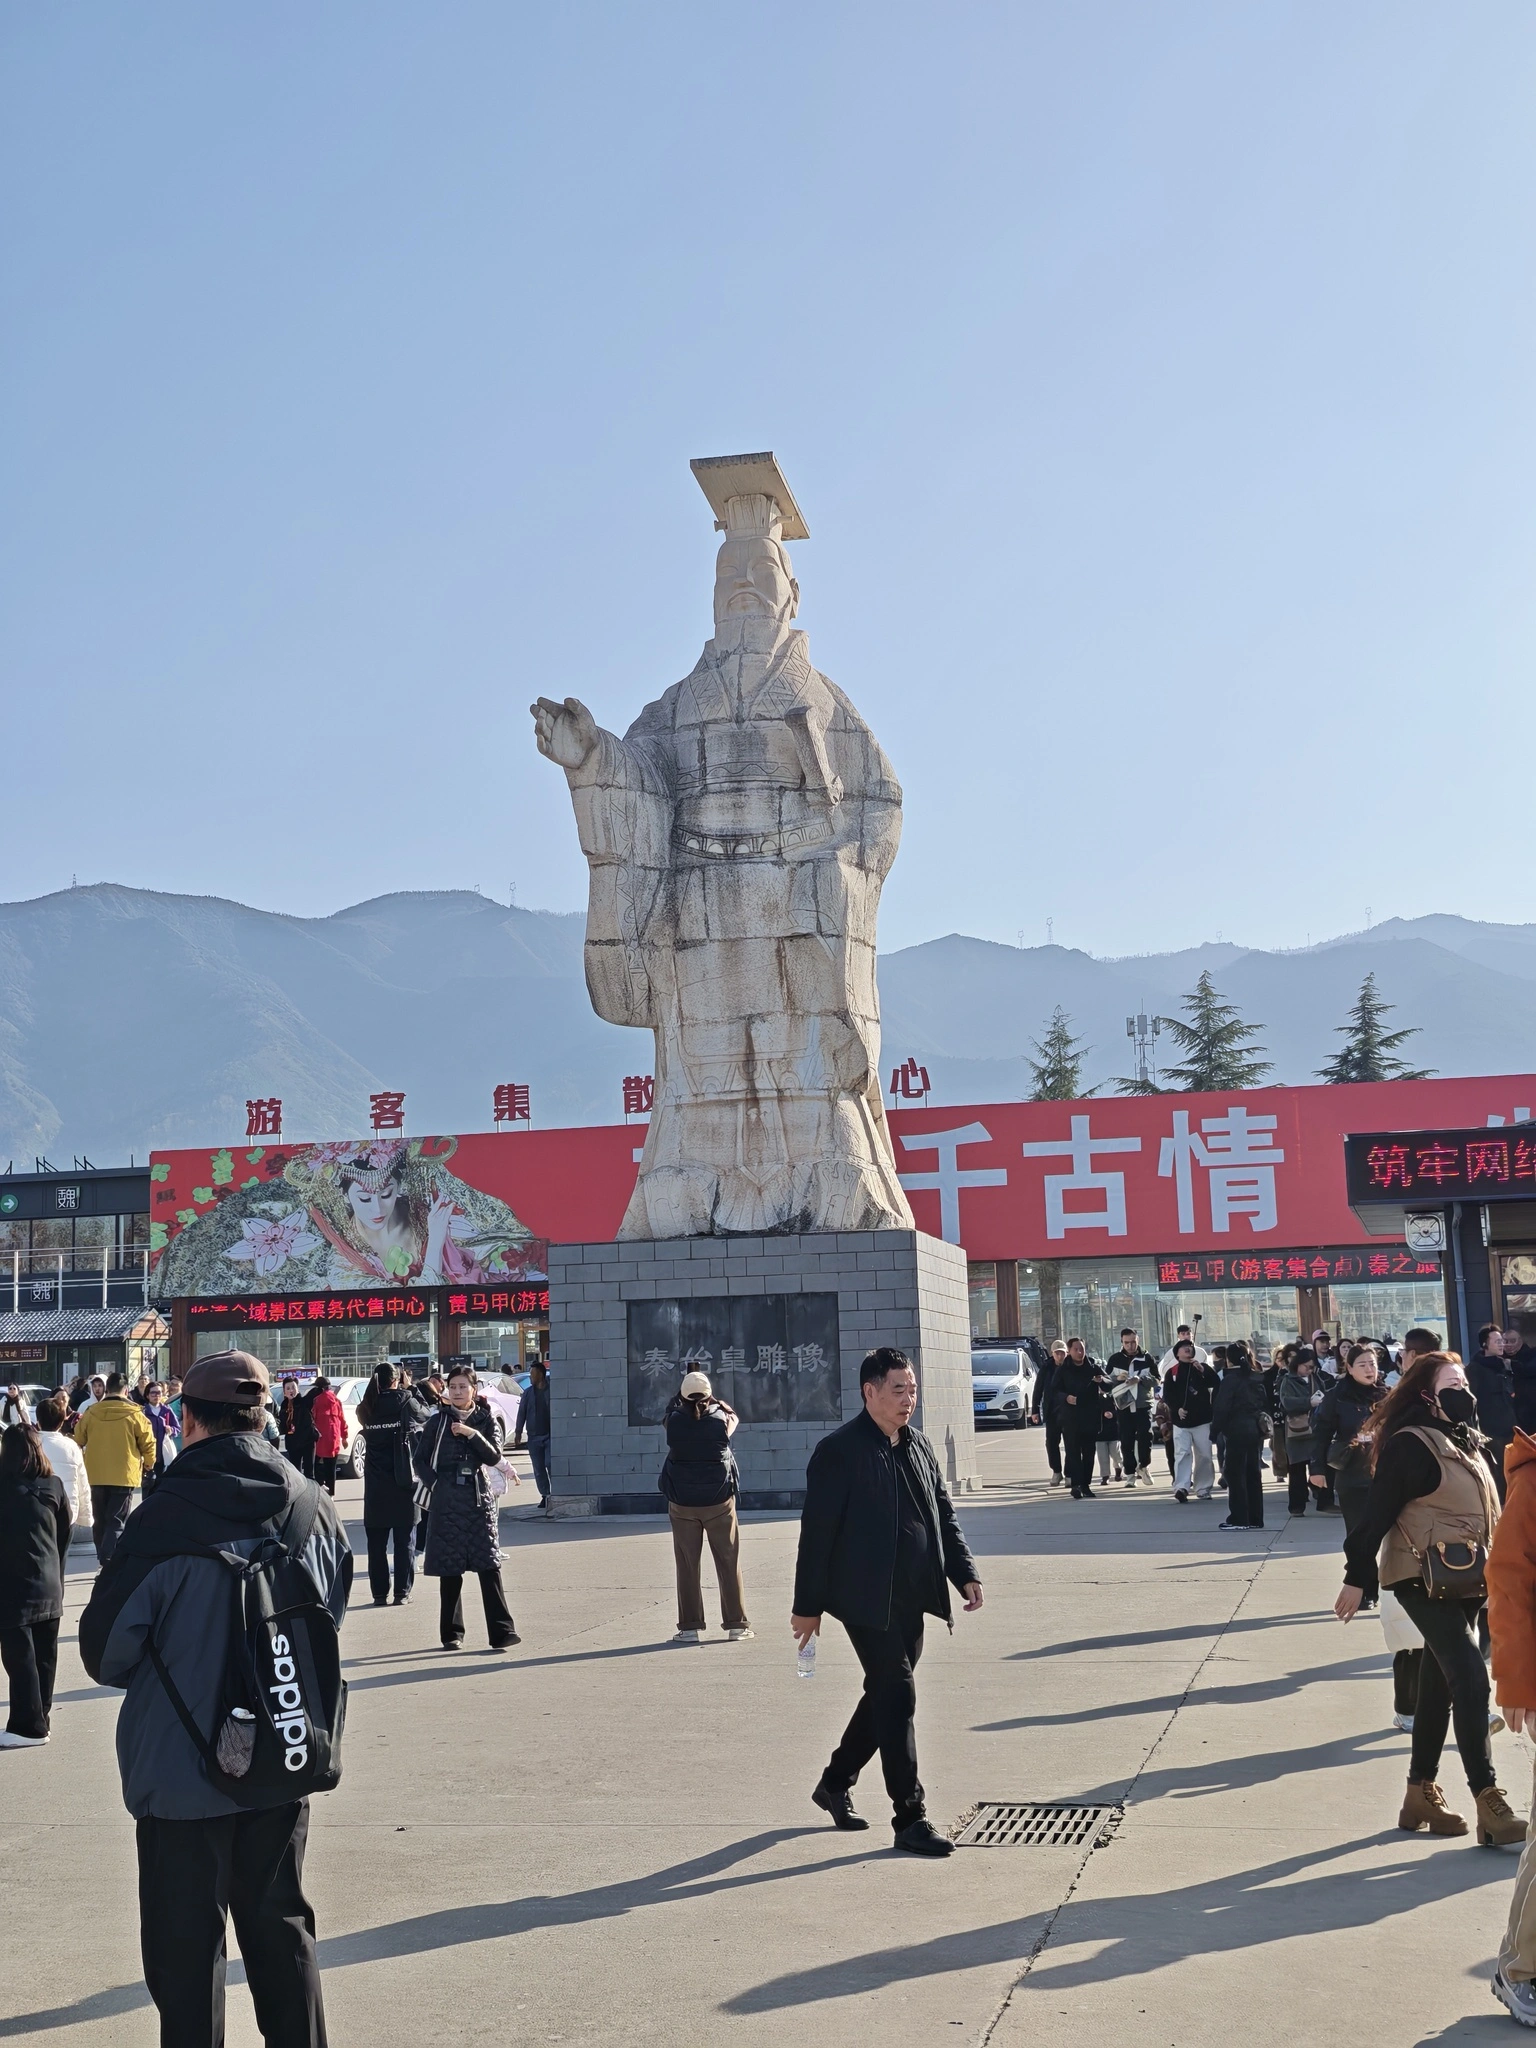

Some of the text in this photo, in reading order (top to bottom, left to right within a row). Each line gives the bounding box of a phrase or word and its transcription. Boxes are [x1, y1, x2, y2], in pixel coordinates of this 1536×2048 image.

[57, 1188, 77, 1209] 魏
[898, 1107, 1285, 1244] 千古情
[639, 1341, 829, 1377] 秦始皇雕像
[270, 1633, 308, 1773] adidas
